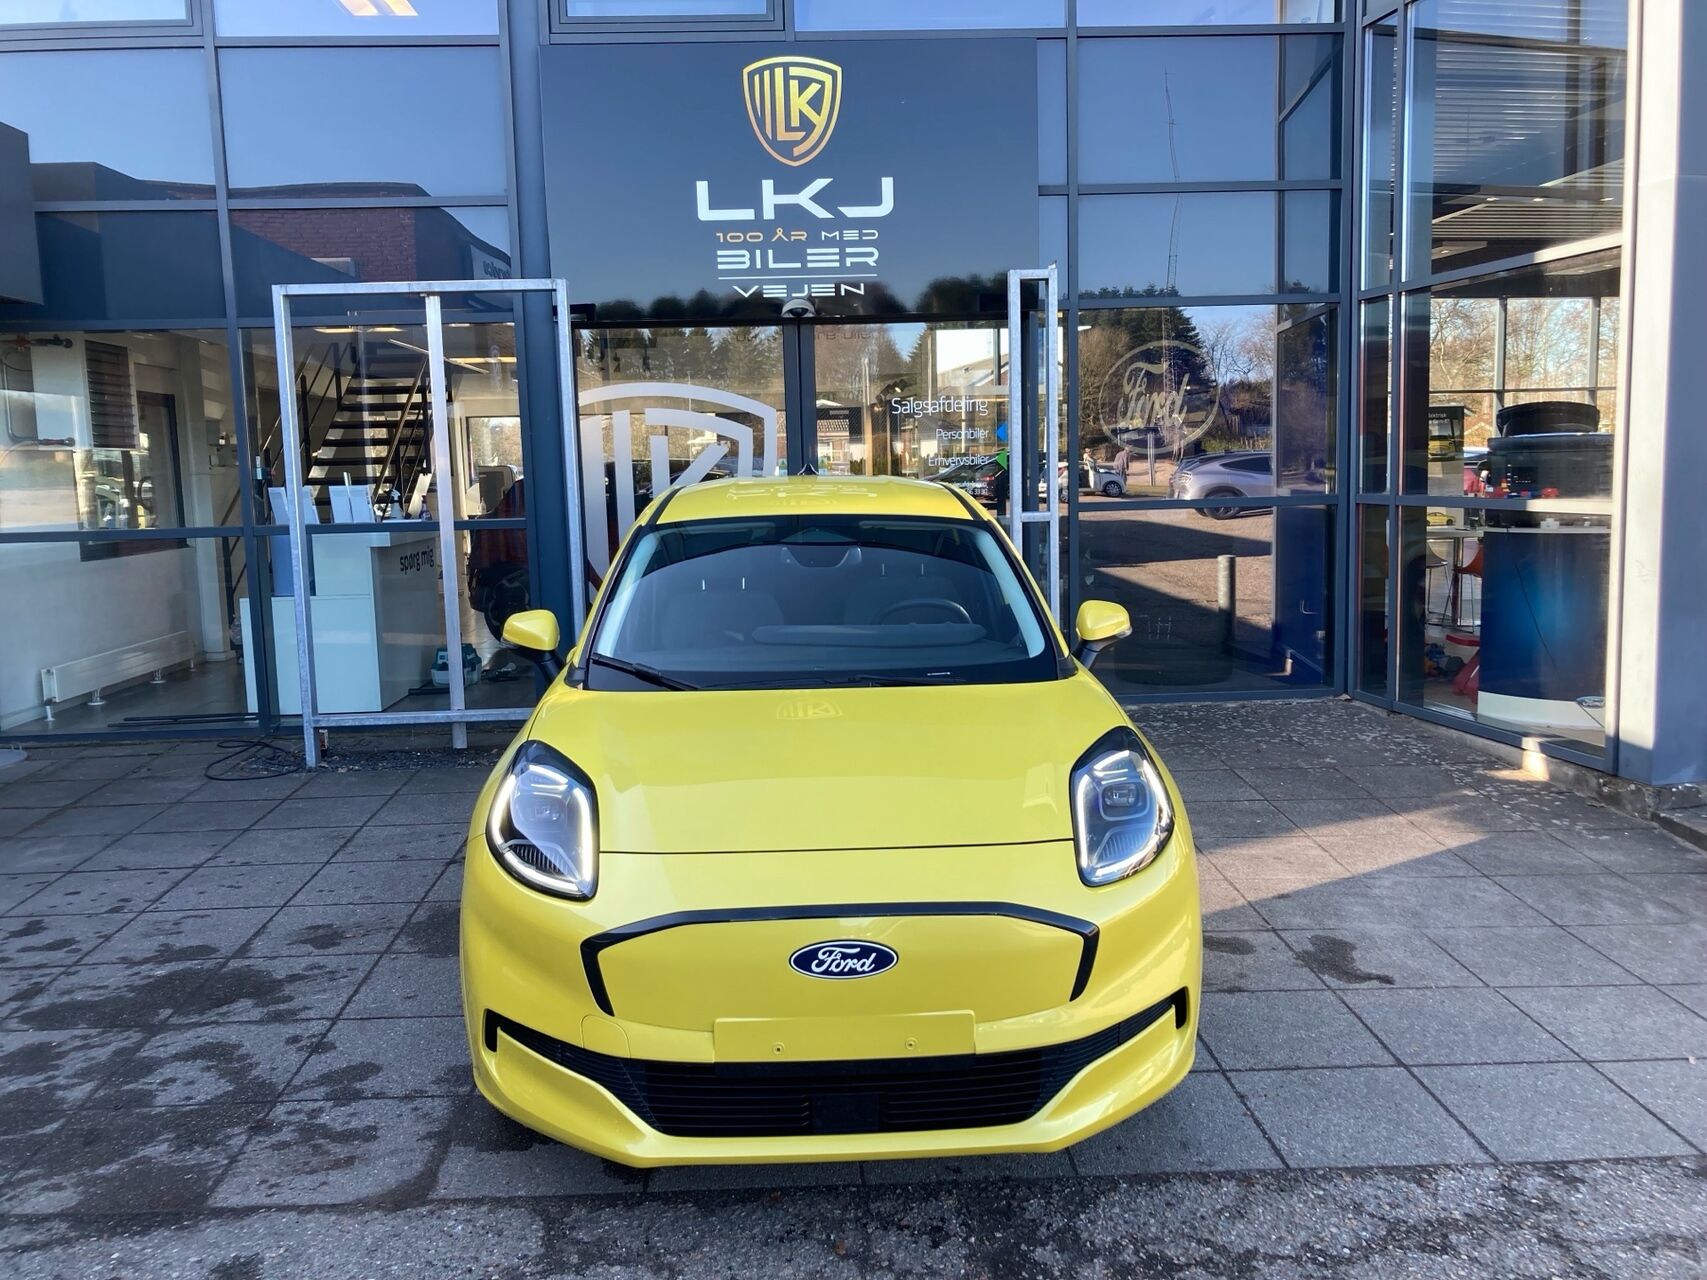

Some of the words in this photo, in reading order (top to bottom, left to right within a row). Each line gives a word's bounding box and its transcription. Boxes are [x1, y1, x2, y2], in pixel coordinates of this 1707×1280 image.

[696, 176, 894, 221] LKJ
[716, 232, 764, 243] 100
[771, 227, 808, 242] ÅR
[821, 229, 879, 241] MED
[717, 247, 879, 270] BILER
[732, 282, 865, 298] VEJEN
[891, 396, 989, 418] Salgsafdeling
[936, 427, 990, 440] Personbiler
[811, 946, 877, 973] Ford
